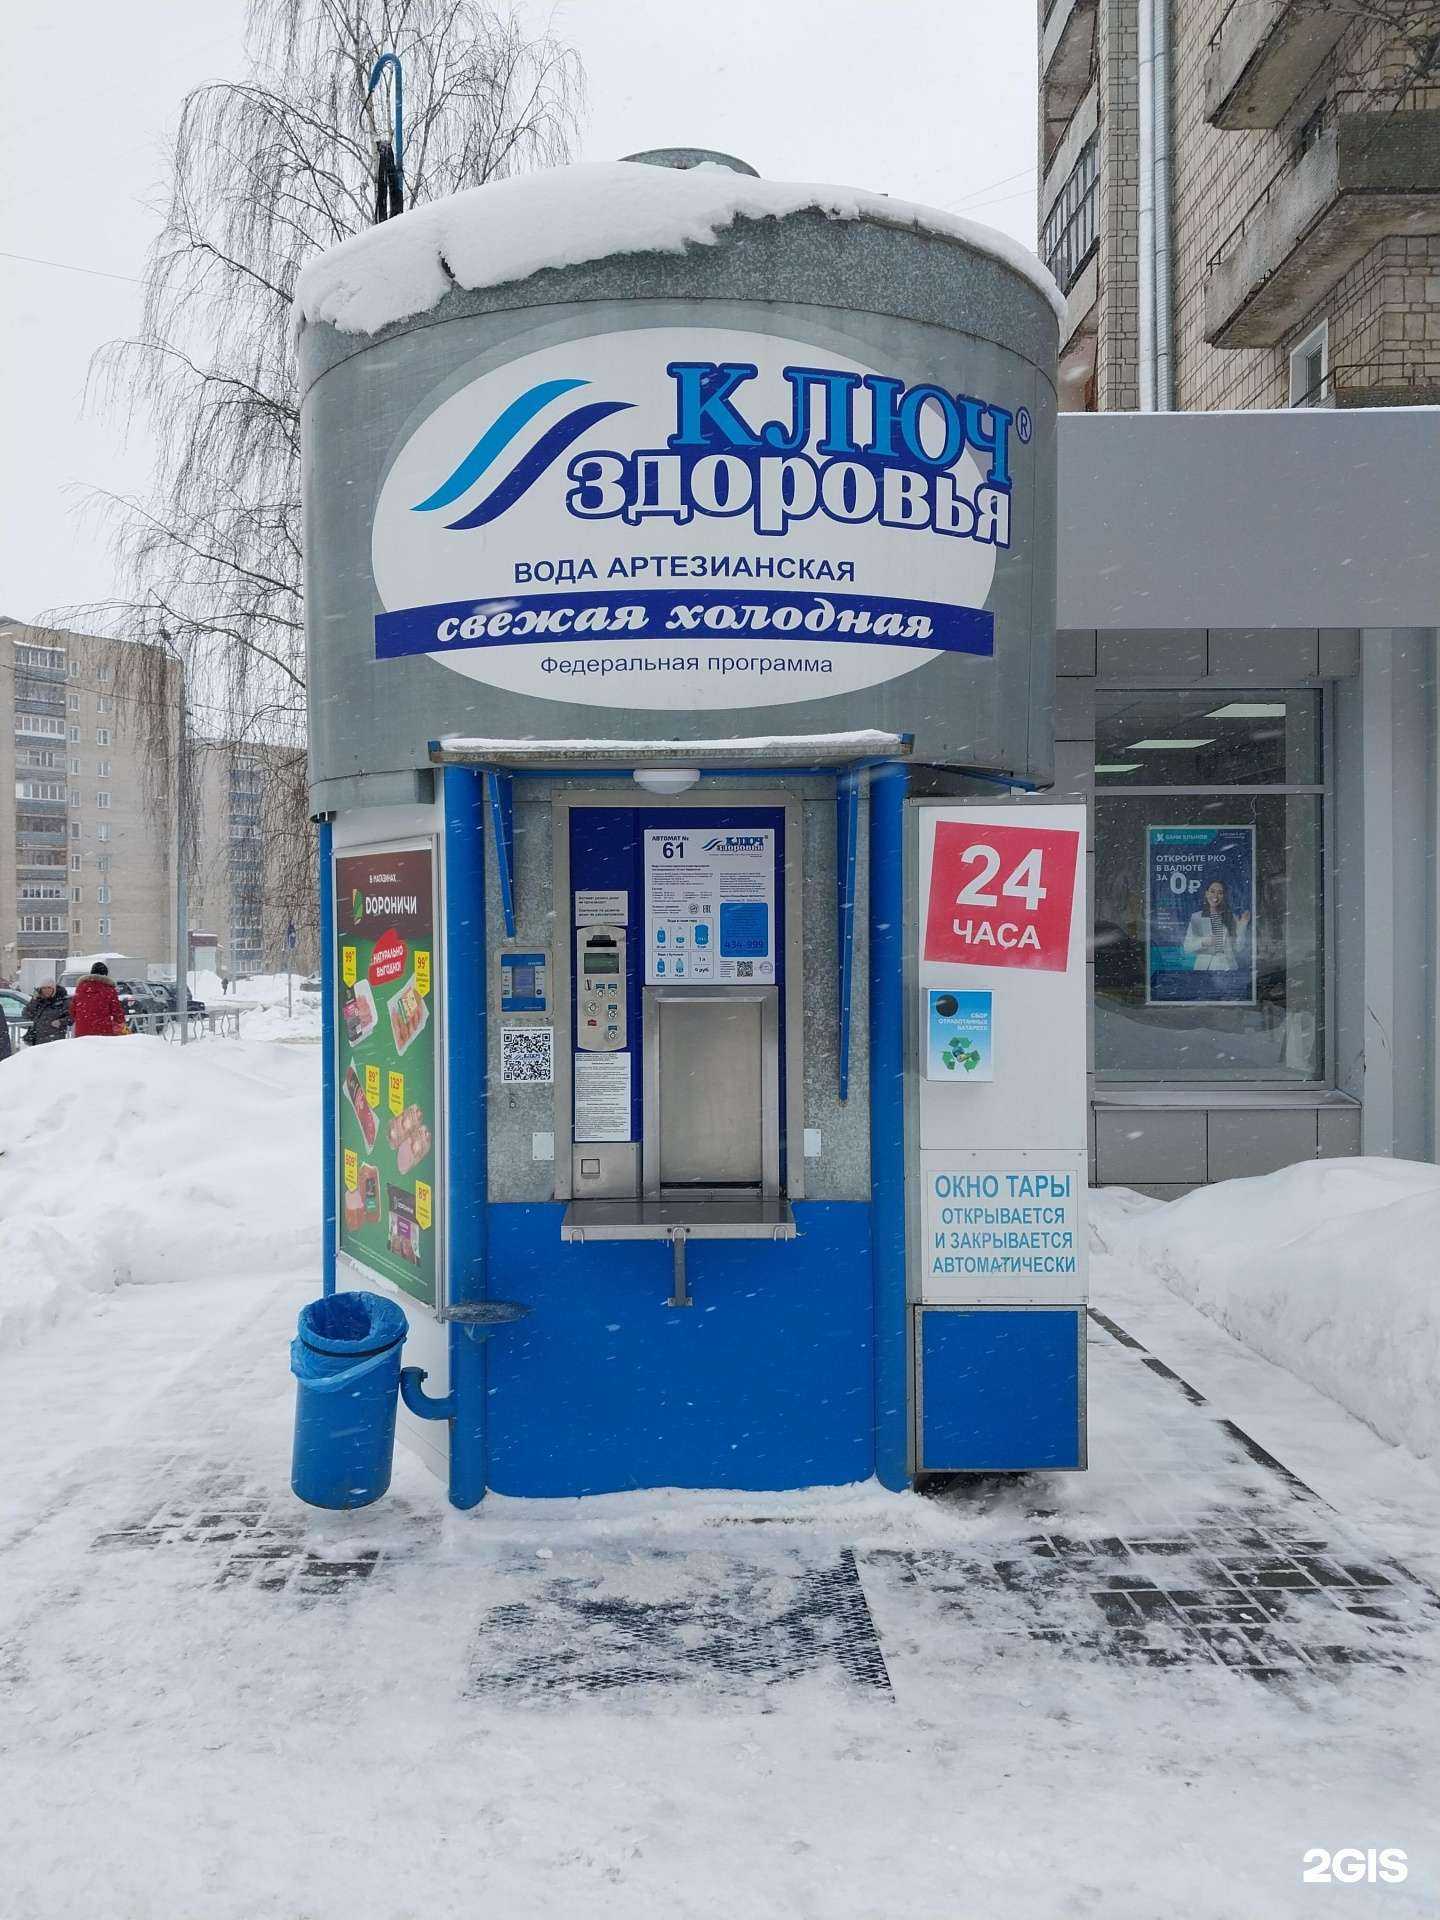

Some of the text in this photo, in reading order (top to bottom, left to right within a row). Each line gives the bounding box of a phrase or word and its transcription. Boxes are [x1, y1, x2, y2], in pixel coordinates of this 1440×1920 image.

[667, 361, 1013, 489] КЛЮЧ
[514, 555, 856, 584] ВОДА АРТЕЗИАНСКАЯ
[436, 598, 935, 641] свежая холодная
[540, 656, 833, 675] Федеральная программа
[662, 842, 684, 859] 61
[1156, 853, 1226, 862] ОТКРОЙТЕ РКО
[955, 843, 1048, 911] 24
[1156, 864, 1204, 872] В ВАЛЮТЕ
[1156, 873, 1168, 881] ЗА
[952, 918, 1042, 950] ЧАСА
[935, 1174, 1071, 1199] ОКНО ТАРЫ
[941, 1207, 1065, 1226] ОТКРЫВАЕТСЯ
[935, 1231, 1073, 1250] И ЗАКРЫВАЕТСЯ
[932, 1255, 1076, 1275] АВТОМАТИЧЕСКИ
